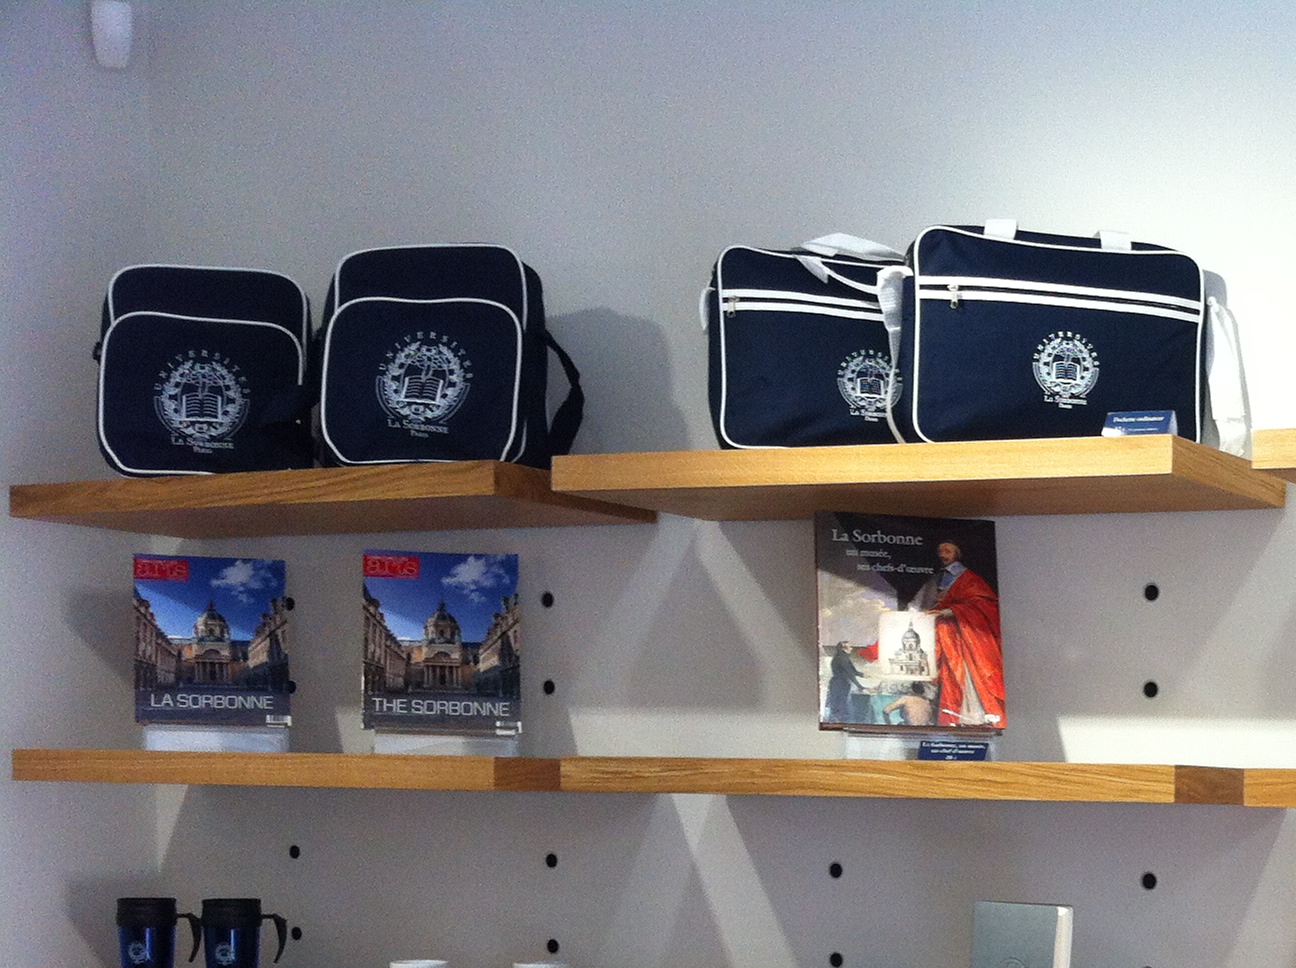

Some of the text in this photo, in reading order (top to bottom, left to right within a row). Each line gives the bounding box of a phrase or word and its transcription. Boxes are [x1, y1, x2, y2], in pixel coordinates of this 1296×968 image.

[831, 528, 924, 546] La Sorbonne
[150, 693, 274, 710] LA SORBONNE
[372, 697, 511, 717] THE SORBONNE
